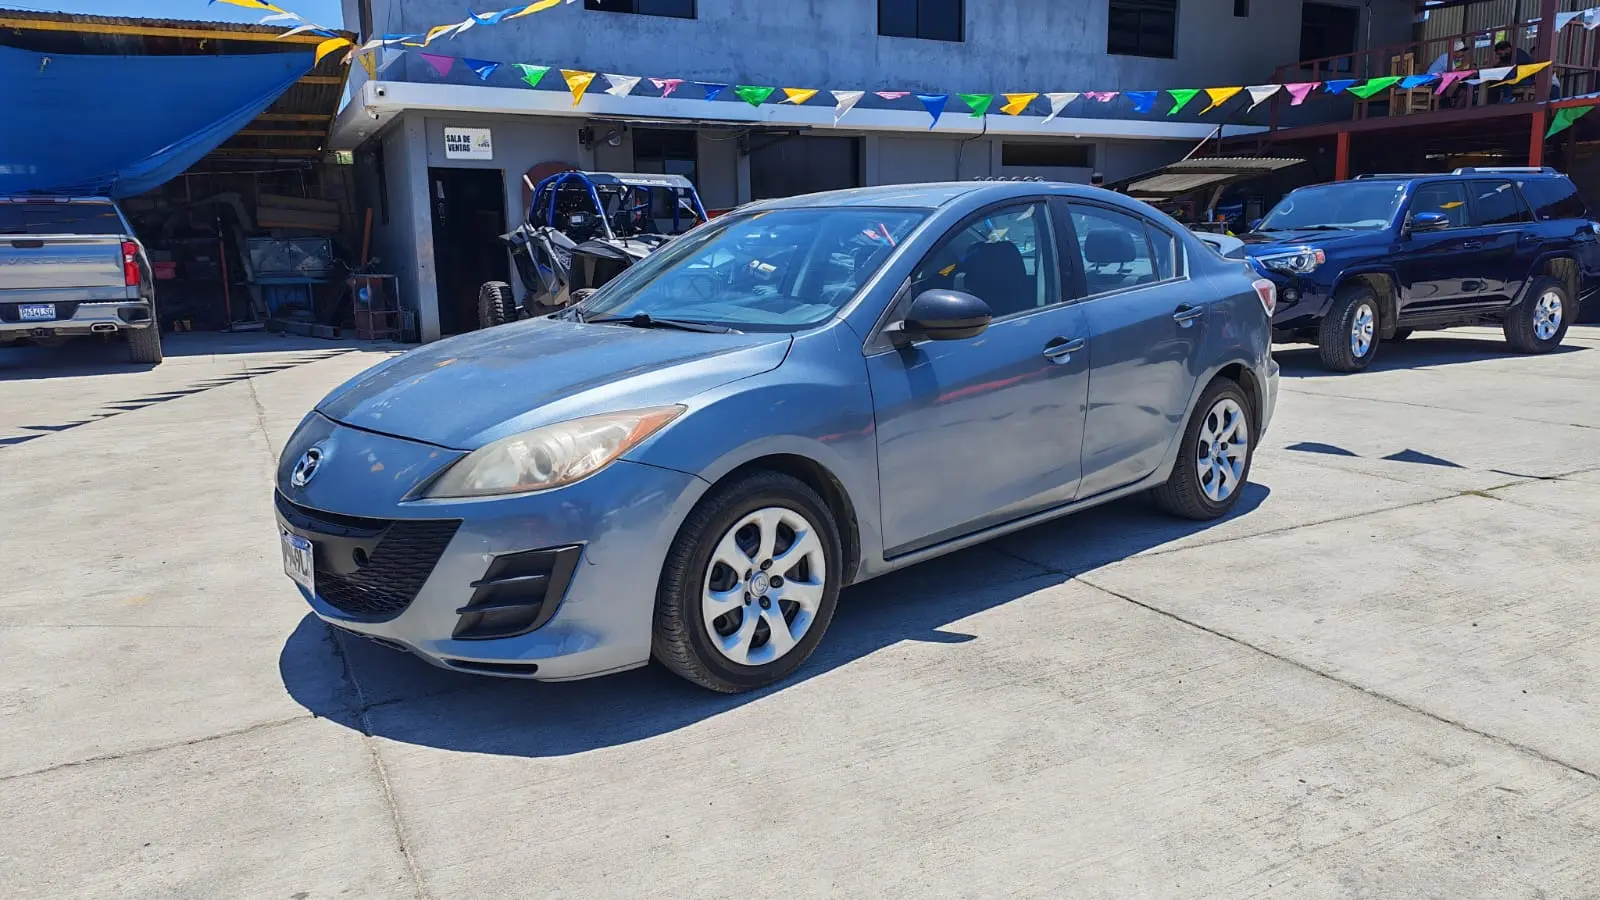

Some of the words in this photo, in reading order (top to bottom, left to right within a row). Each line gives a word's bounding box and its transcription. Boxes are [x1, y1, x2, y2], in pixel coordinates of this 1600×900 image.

[446, 134, 462, 143] SALA
[462, 135, 471, 143] DE
[447, 143, 471, 152] VENTAS
